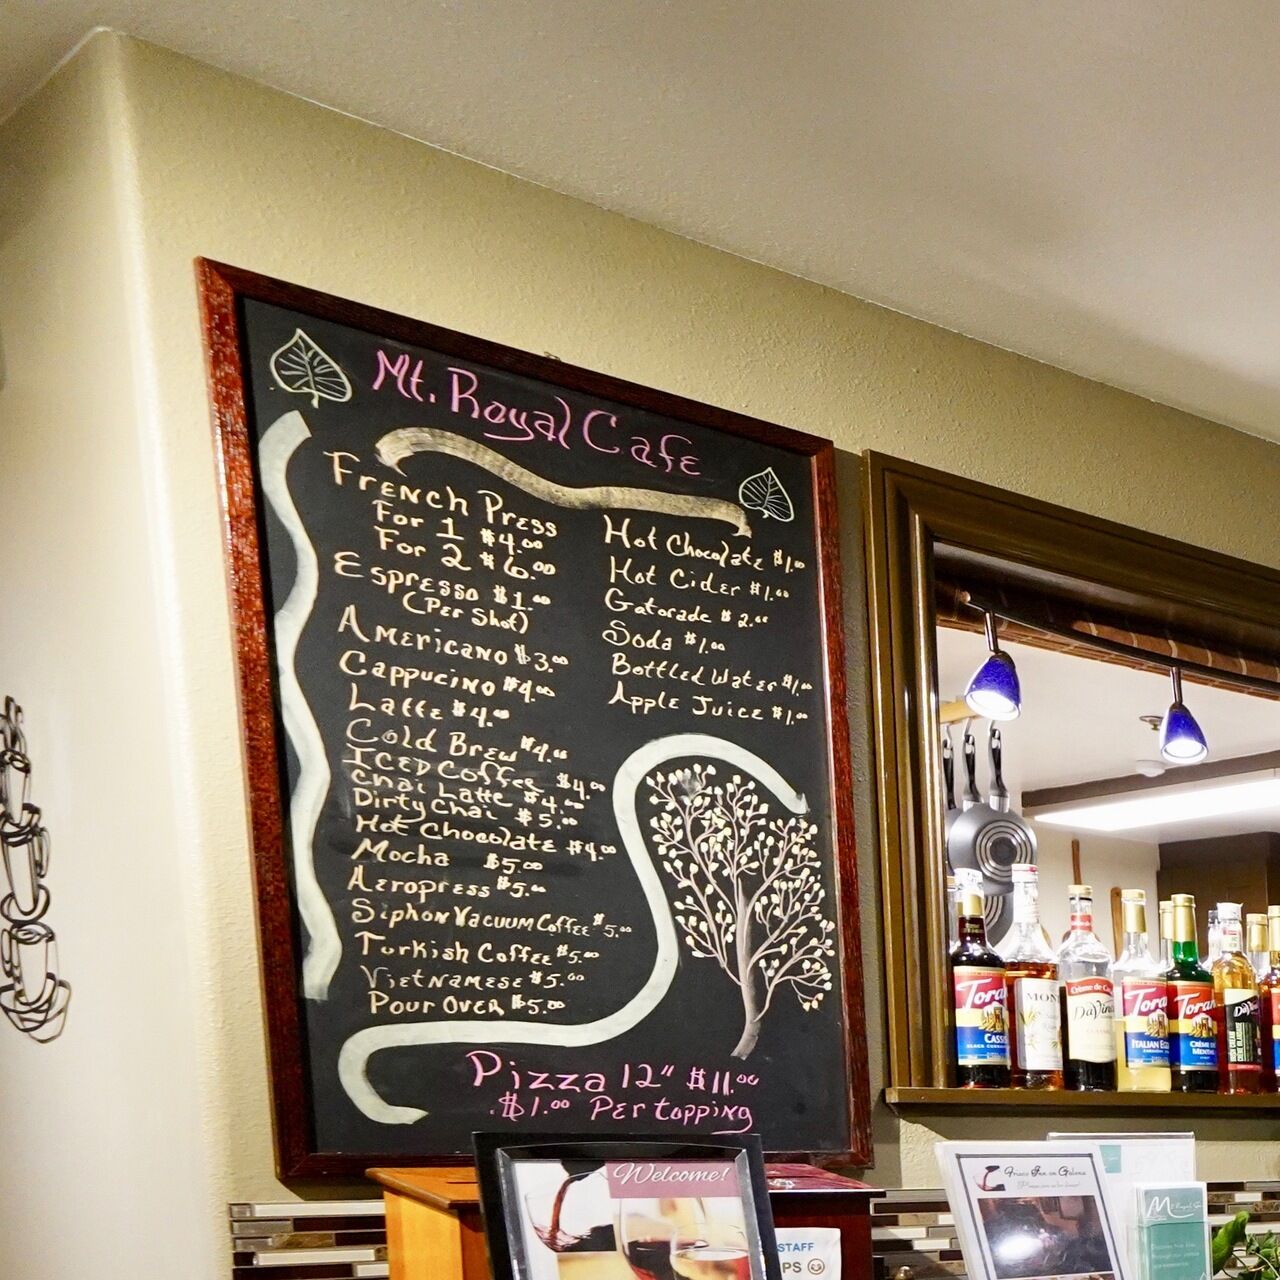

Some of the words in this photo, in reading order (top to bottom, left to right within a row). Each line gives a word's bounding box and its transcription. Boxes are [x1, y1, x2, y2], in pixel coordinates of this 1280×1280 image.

[372, 349, 436, 403] Mt.
[447, 366, 571, 450] Royal
[583, 410, 701, 476] Cafe
[323, 451, 469, 516] French
[477, 489, 558, 537] Press
[372, 500, 424, 527] For
[436, 517, 464, 540] 1
[374, 526, 426, 556] For
[441, 543, 472, 571] 2
[603, 514, 658, 551] Hot
[666, 532, 764, 571] Chocolate
[334, 551, 479, 601] Espresso
[610, 556, 657, 585] Hot
[670, 567, 740, 596] Cider
[471, 607, 528, 634] Shot)
[605, 587, 712, 623] Gatorade
[338, 604, 508, 665] Americano
[602, 620, 672, 651] Soda
[612, 653, 706, 686] Bottled
[711, 668, 777, 692] Water
[349, 682, 443, 720] Latte
[608, 681, 680, 714] Apple
[692, 695, 764, 720] Juice
[346, 718, 437, 752] Cold
[449, 732, 518, 762] Brew
[350, 768, 427, 794] Chai
[439, 782, 513, 807] Latte
[438, 761, 545, 792] Coffee
[352, 787, 426, 823] Dirty
[431, 798, 498, 820] Chai
[351, 838, 450, 867] Mocha
[356, 814, 409, 836] Hot
[420, 821, 557, 853] Chocolate
[347, 864, 490, 903] Aeropress
[351, 898, 451, 928] Siphon
[454, 906, 535, 930] Vacuum
[537, 914, 591, 937] Coffee
[354, 931, 469, 962] Turkish
[477, 942, 553, 966] Coffee
[360, 965, 523, 990] Vietnamese
[367, 990, 435, 1015] Pour
[443, 995, 505, 1016] Over
[465, 1050, 606, 1093] Pizza
[590, 1095, 646, 1120] Per
[654, 1096, 754, 1135] topping
[613, 1162, 730, 1185] Welcome!
[776, 1242, 814, 1253] STAFF
[782, 1261, 802, 1273] PS
